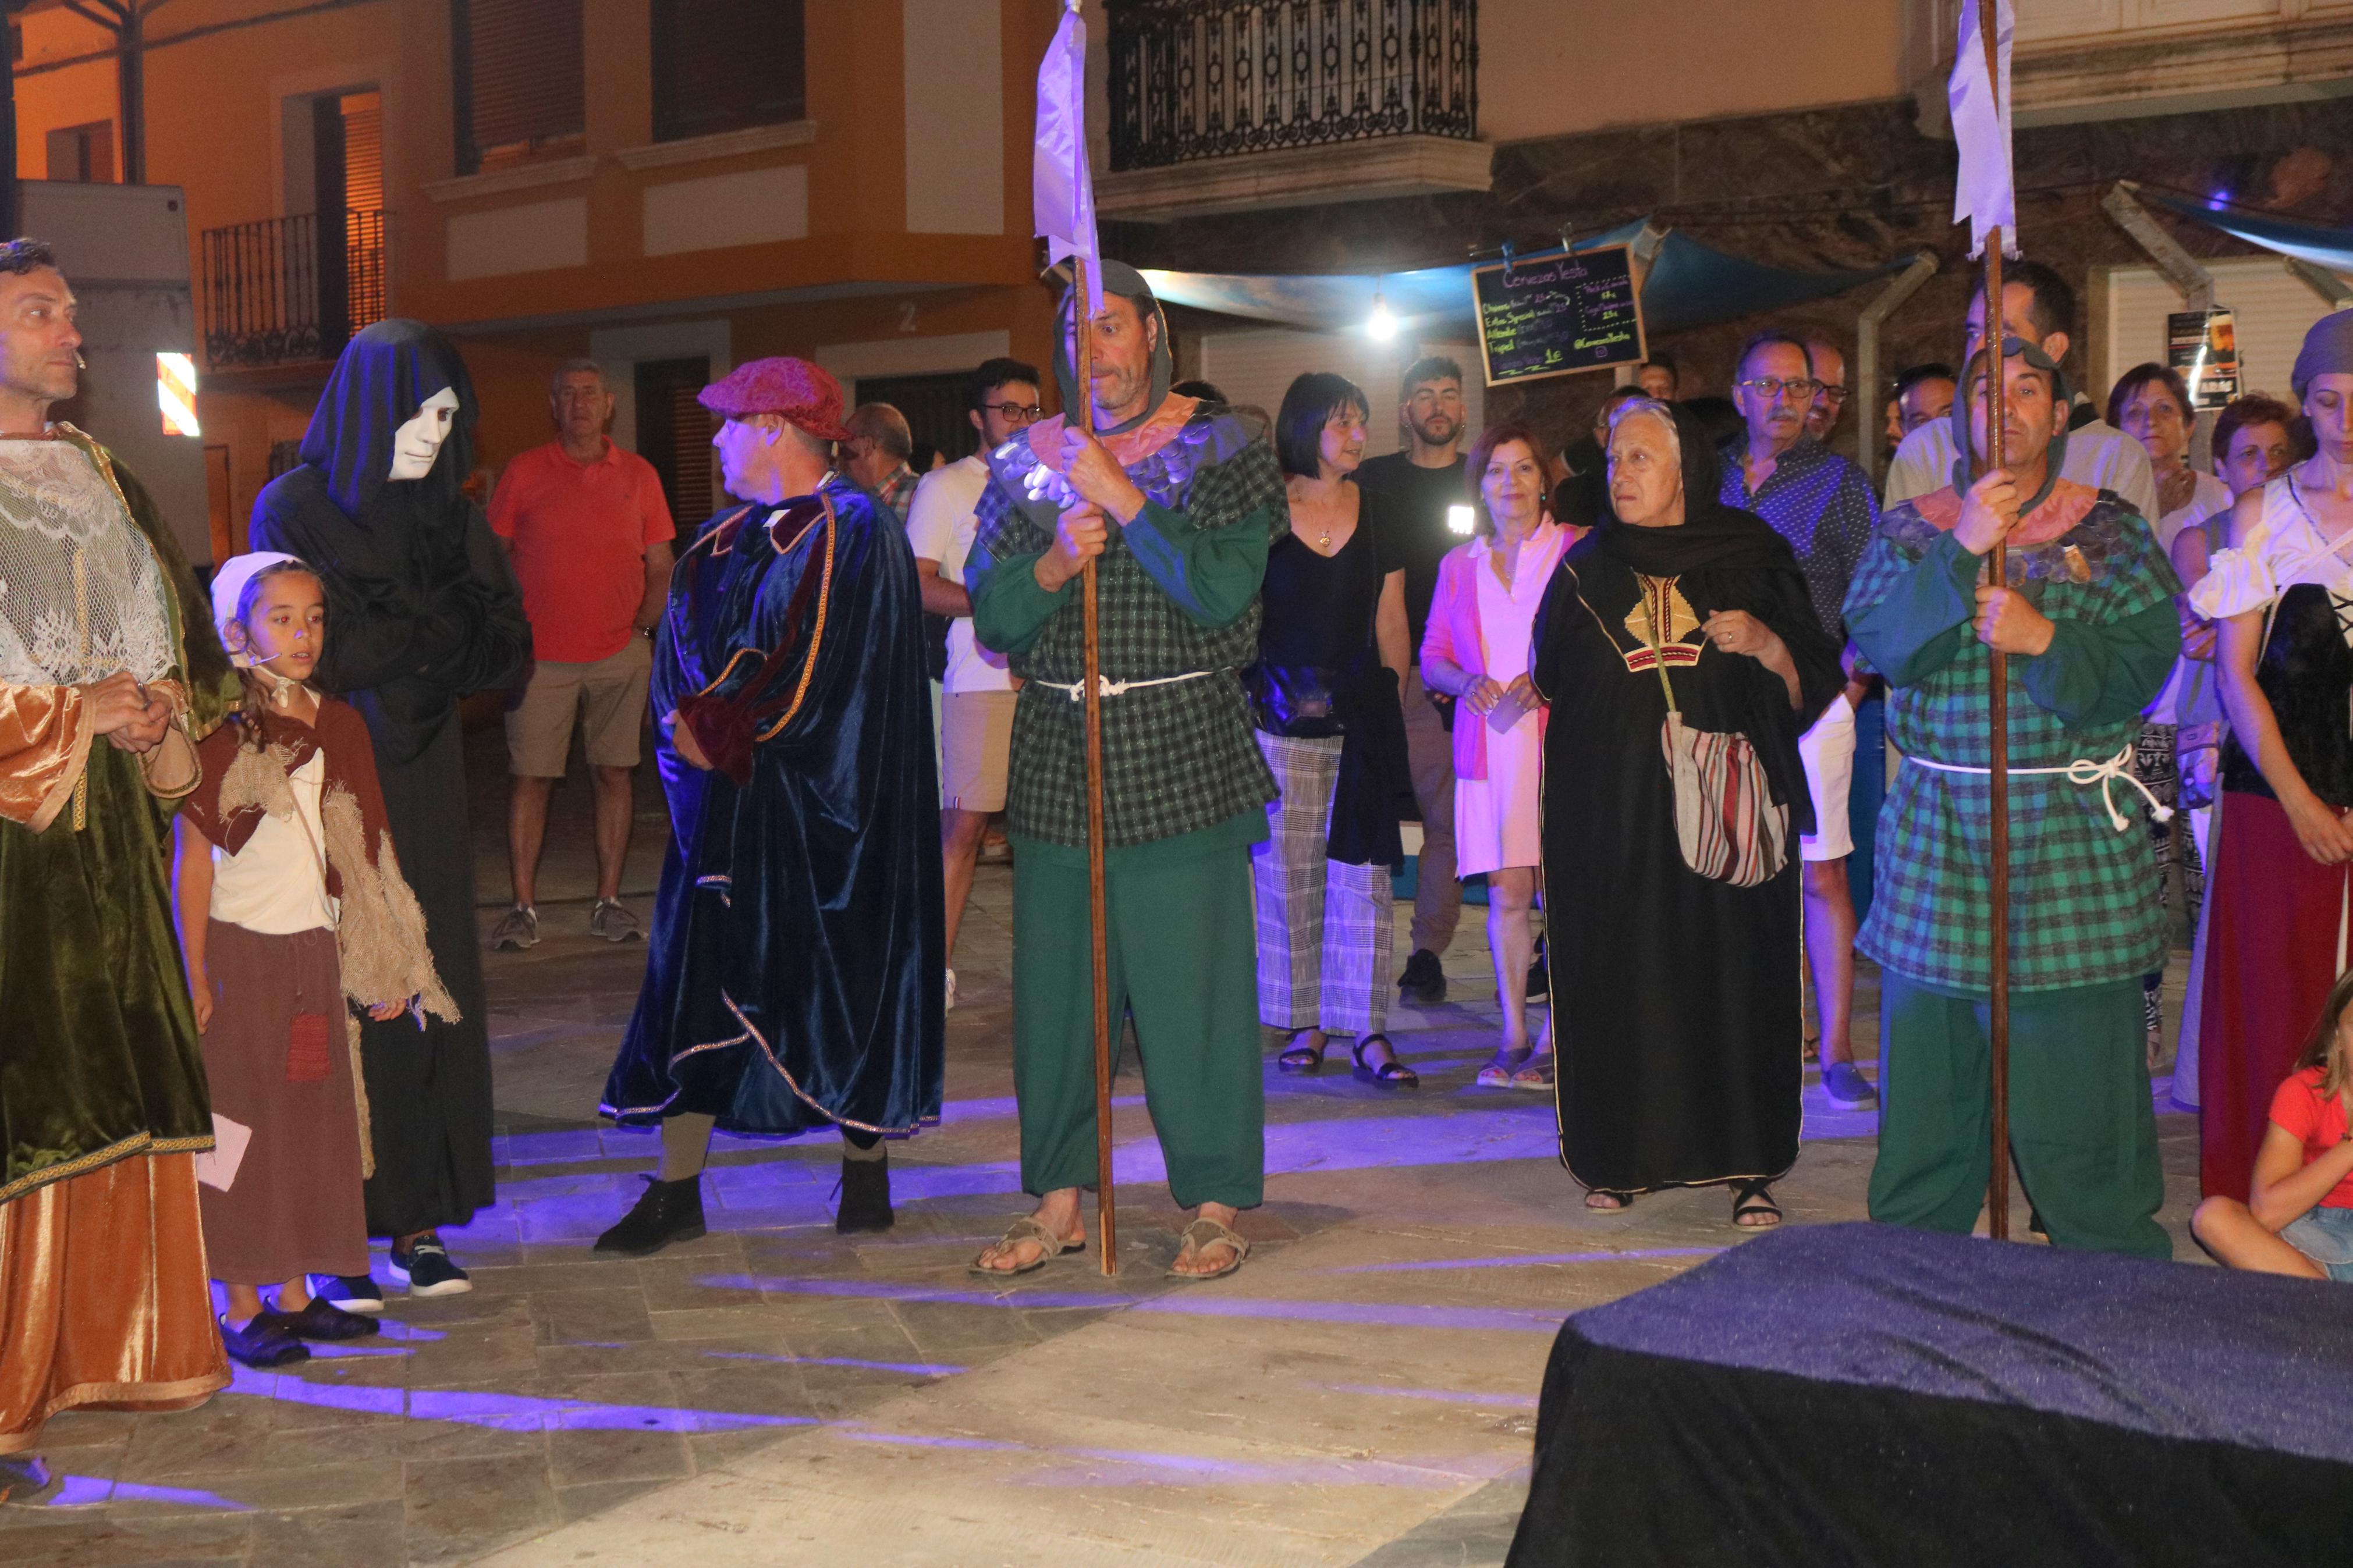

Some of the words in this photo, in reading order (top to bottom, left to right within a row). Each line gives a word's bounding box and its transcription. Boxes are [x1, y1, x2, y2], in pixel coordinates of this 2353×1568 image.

[1502, 269, 1557, 289] Cervezas
[1556, 259, 1588, 280] Yesta
[899, 300, 917, 332] 2
